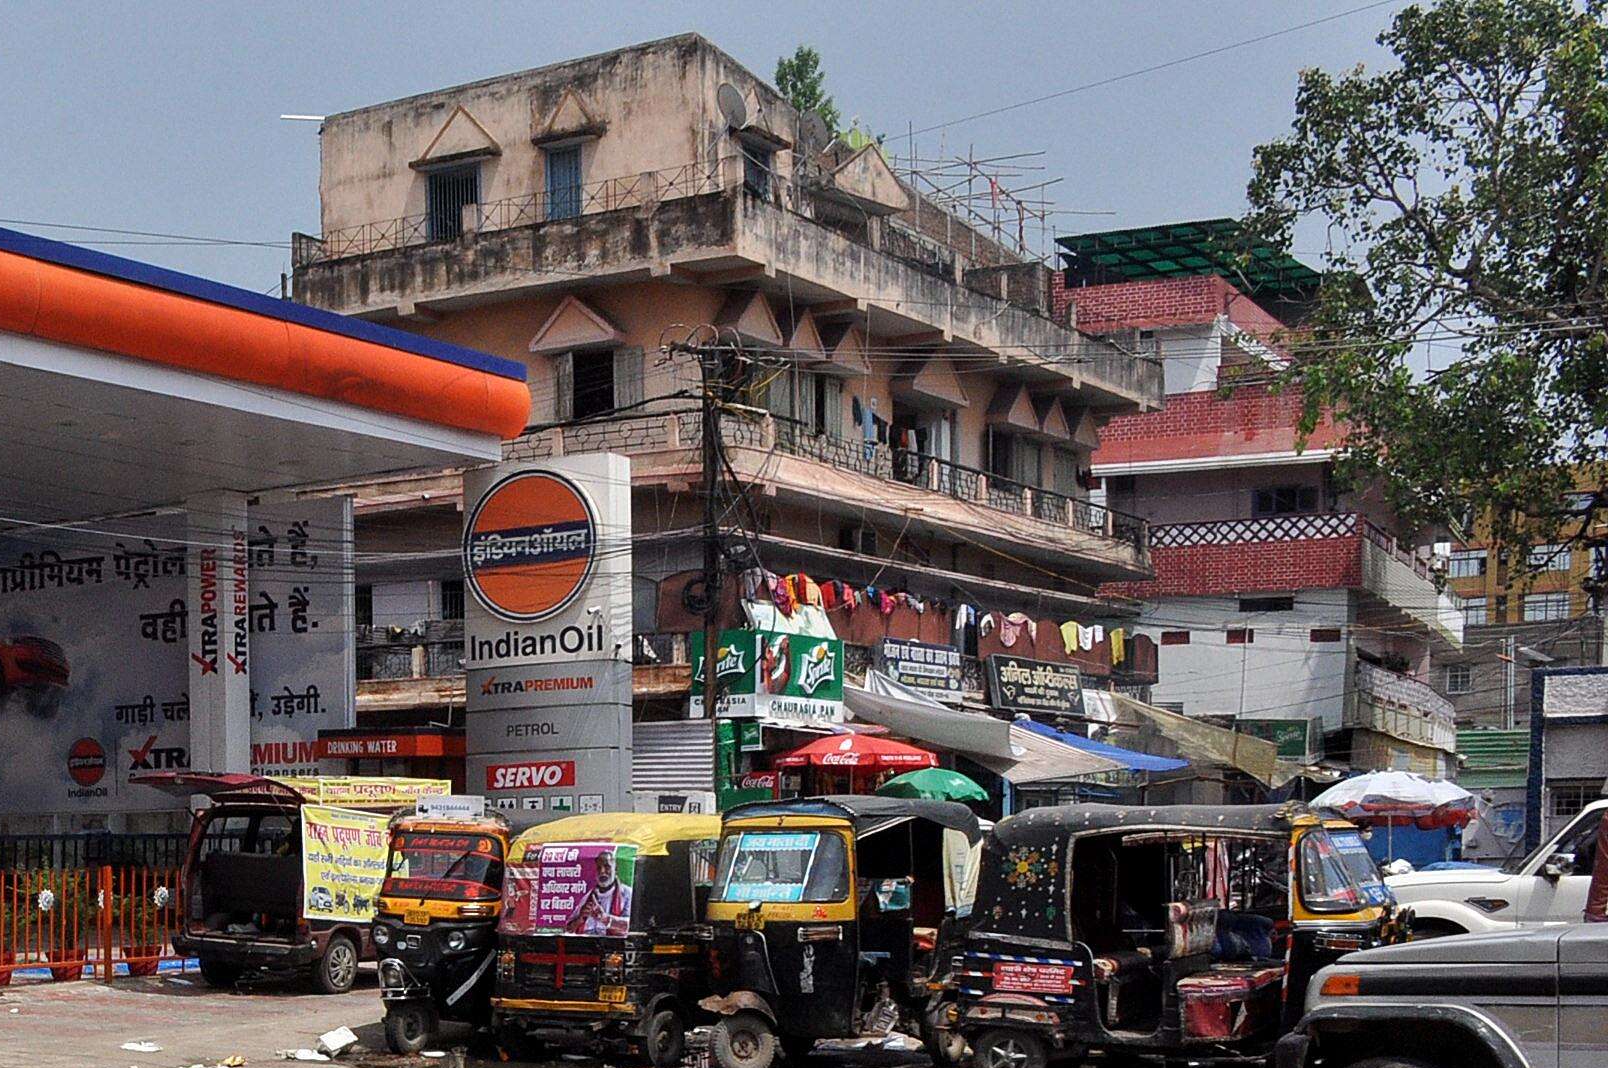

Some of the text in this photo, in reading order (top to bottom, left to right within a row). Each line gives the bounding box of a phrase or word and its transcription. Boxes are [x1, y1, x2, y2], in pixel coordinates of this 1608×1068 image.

[471, 529, 588, 565] इंडियनऑयल
[114, 542, 186, 591] पेट्रोल
[192, 549, 218, 676] XTRAPOWER
[227, 531, 247, 675] XTRAREWARDS
[470, 625, 604, 661] IndianOil
[1000, 660, 1032, 685] अनिल
[480, 675, 594, 697] XTRAPREMIUM
[115, 694, 157, 725] गाड़ी
[771, 700, 835, 716] CHAURASIA PAN
[506, 723, 559, 737] PETROL
[327, 740, 397, 754] DRINKING WATER
[493, 765, 563, 787] SERVO
[67, 786, 109, 798] IndianOil
[660, 804, 682, 812] ENTRY
